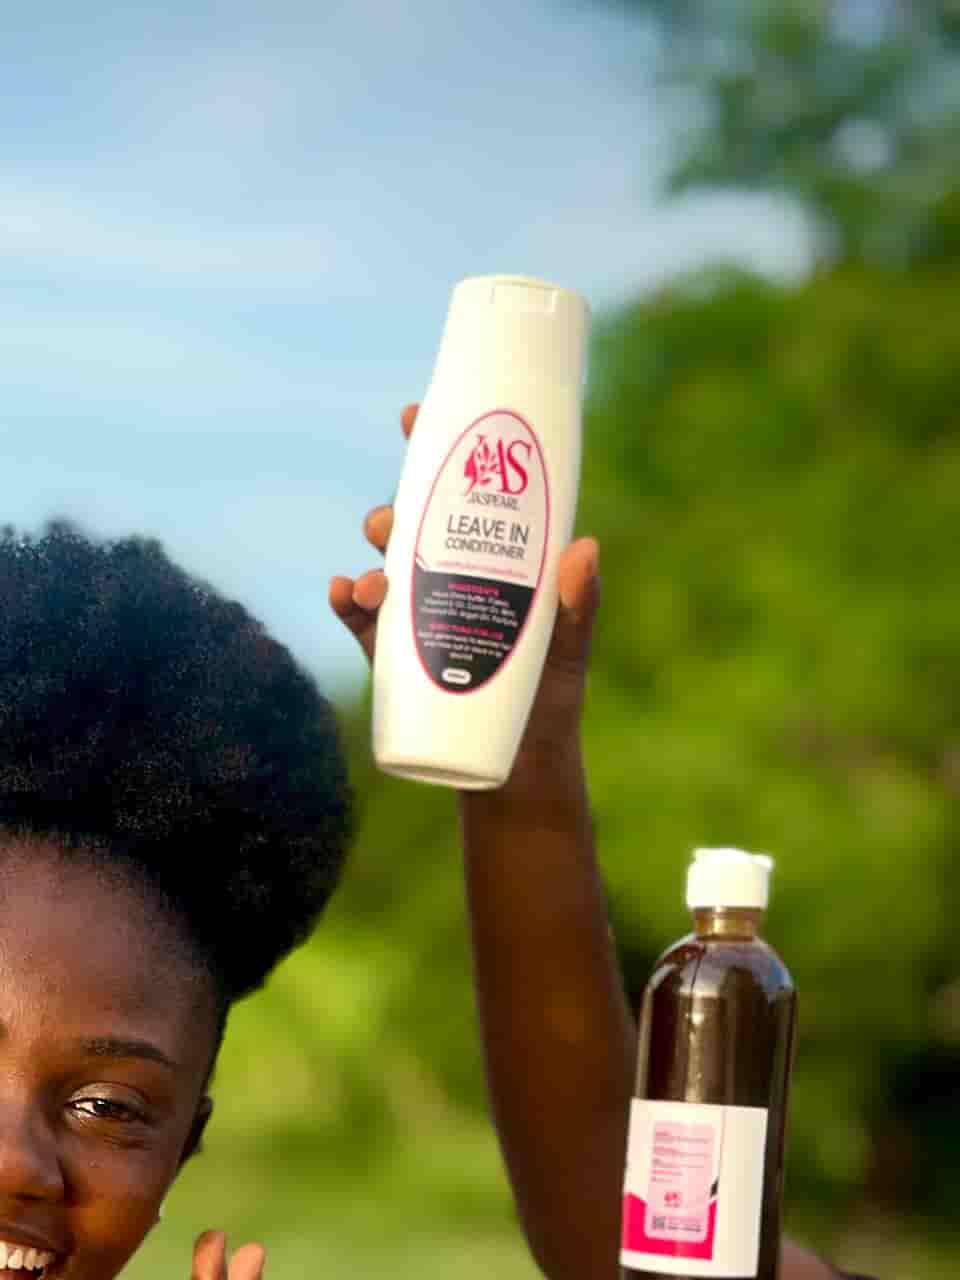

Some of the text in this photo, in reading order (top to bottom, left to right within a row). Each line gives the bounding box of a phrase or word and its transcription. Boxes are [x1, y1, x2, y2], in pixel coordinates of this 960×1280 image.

[447, 513, 530, 545] LEAVE IN
[445, 537, 526, 560] CONDITIONER
